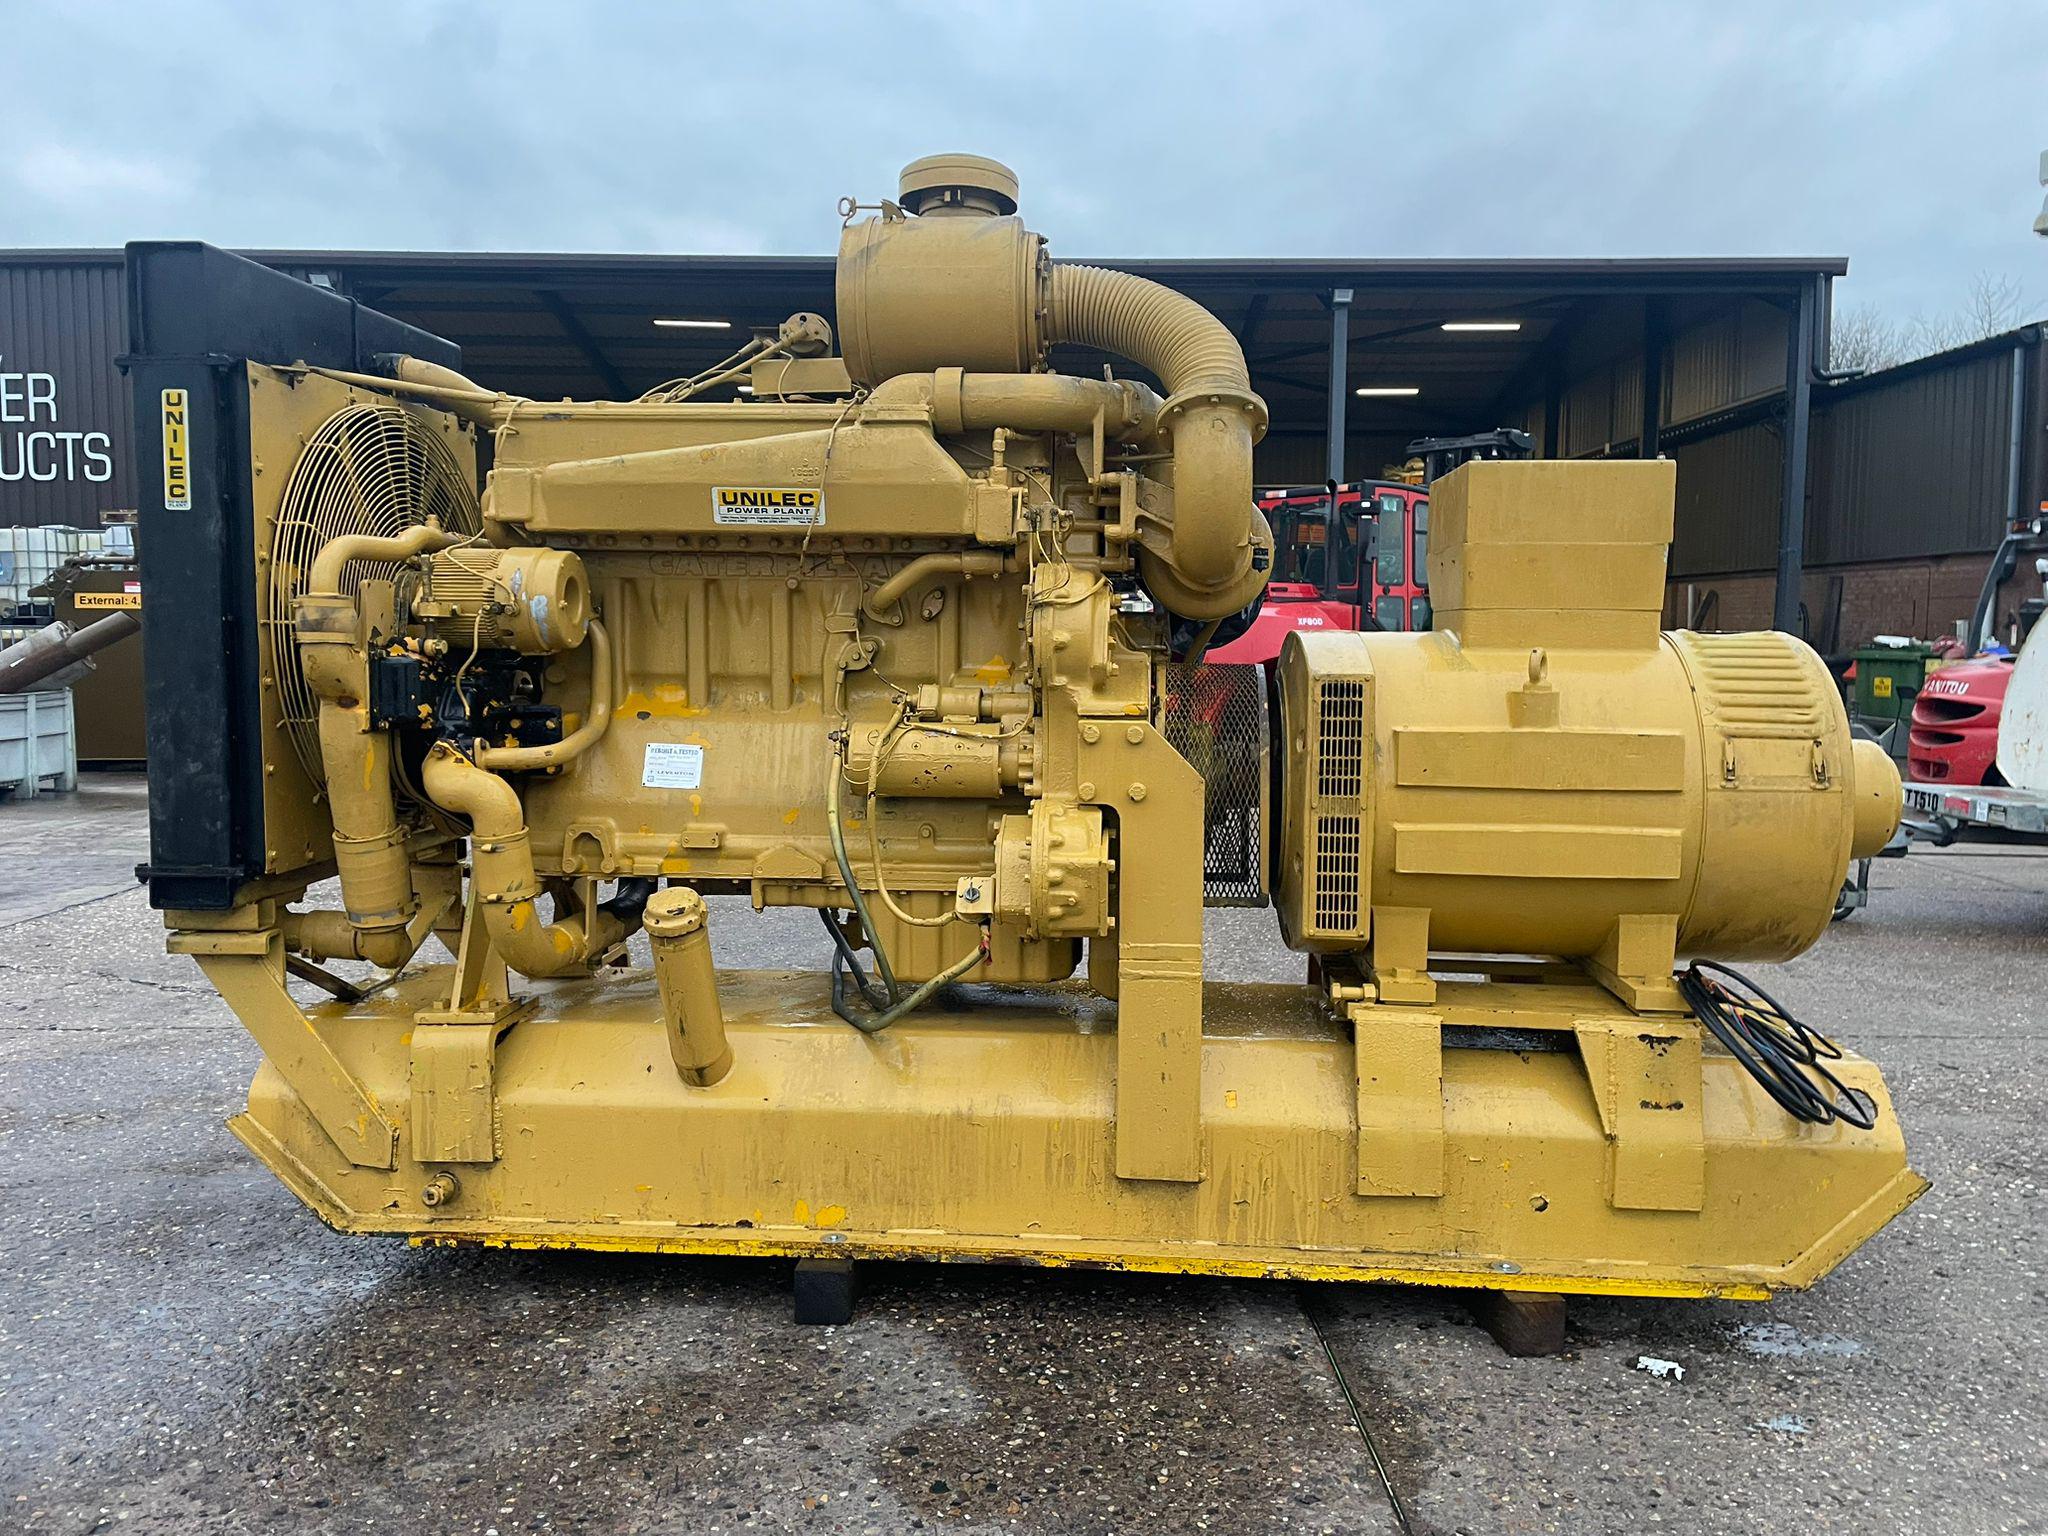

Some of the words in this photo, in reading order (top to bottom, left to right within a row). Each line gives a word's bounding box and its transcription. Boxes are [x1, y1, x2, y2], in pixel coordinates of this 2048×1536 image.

[0, 373, 57, 422] ER
[0, 432, 112, 482] UCTS
[165, 392, 186, 498] UNILEC
[721, 491, 815, 506] UNILEC
[773, 507, 811, 515] PLANT
[649, 553, 914, 578] CATERPILA
[80, 595, 128, 605] External:
